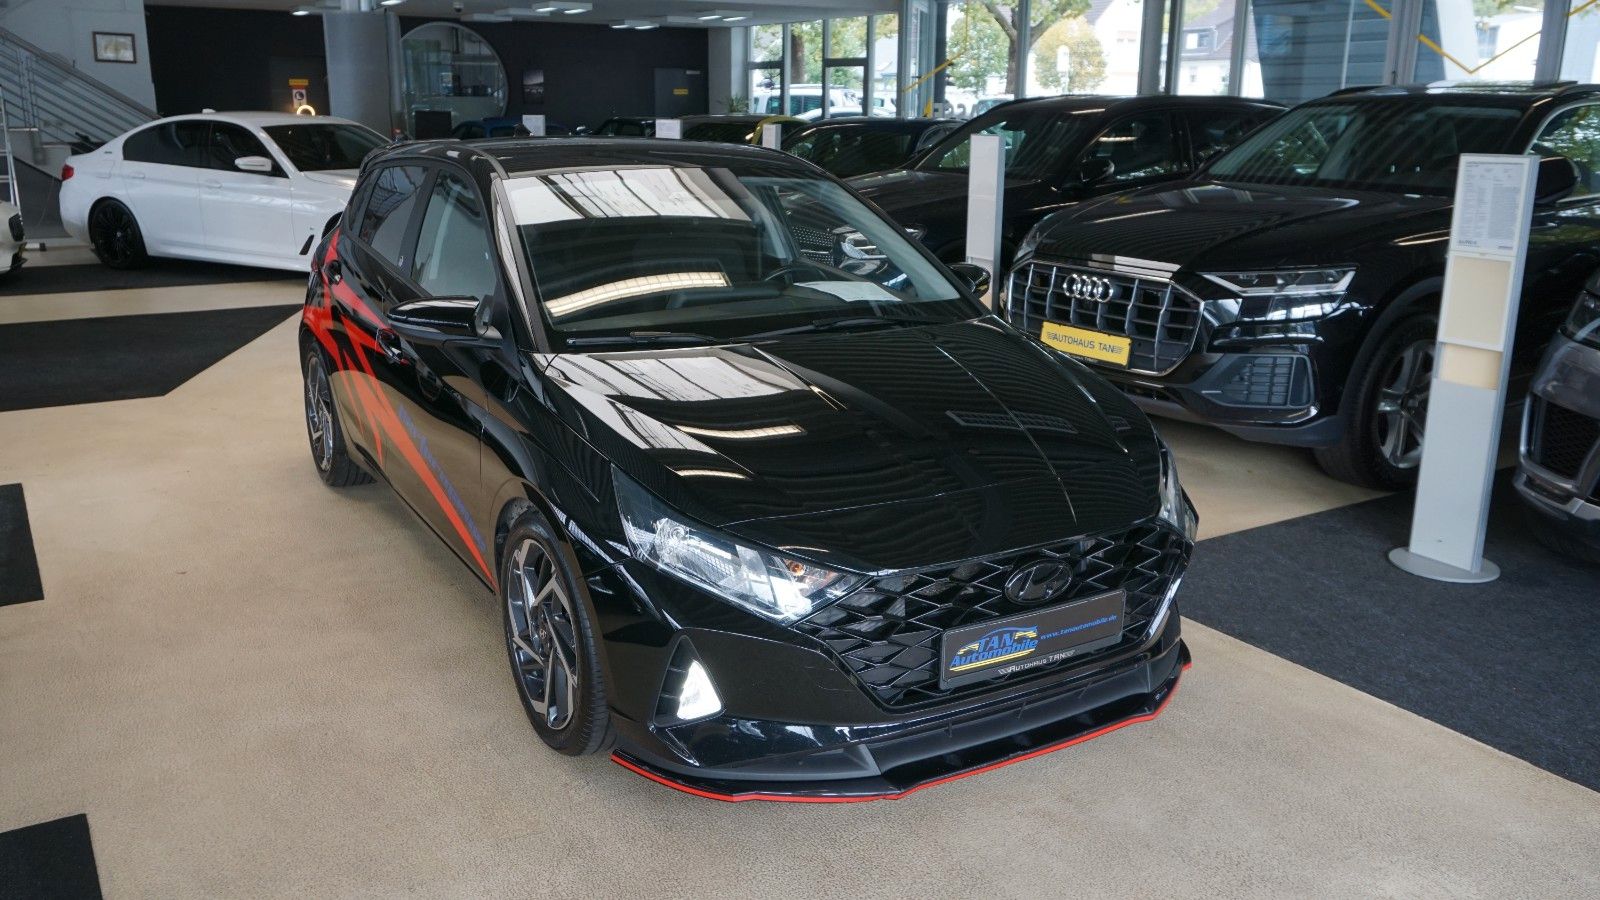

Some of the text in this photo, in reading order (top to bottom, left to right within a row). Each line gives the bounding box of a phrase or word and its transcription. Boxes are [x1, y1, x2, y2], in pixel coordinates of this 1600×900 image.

[1053, 333, 1115, 354] AUTOHAUS TAN
[1040, 614, 1117, 640] www.tanautomobile.de
[977, 632, 1015, 652] TAN
[951, 639, 1039, 667] Automobile
[1048, 652, 1066, 663] TAN
